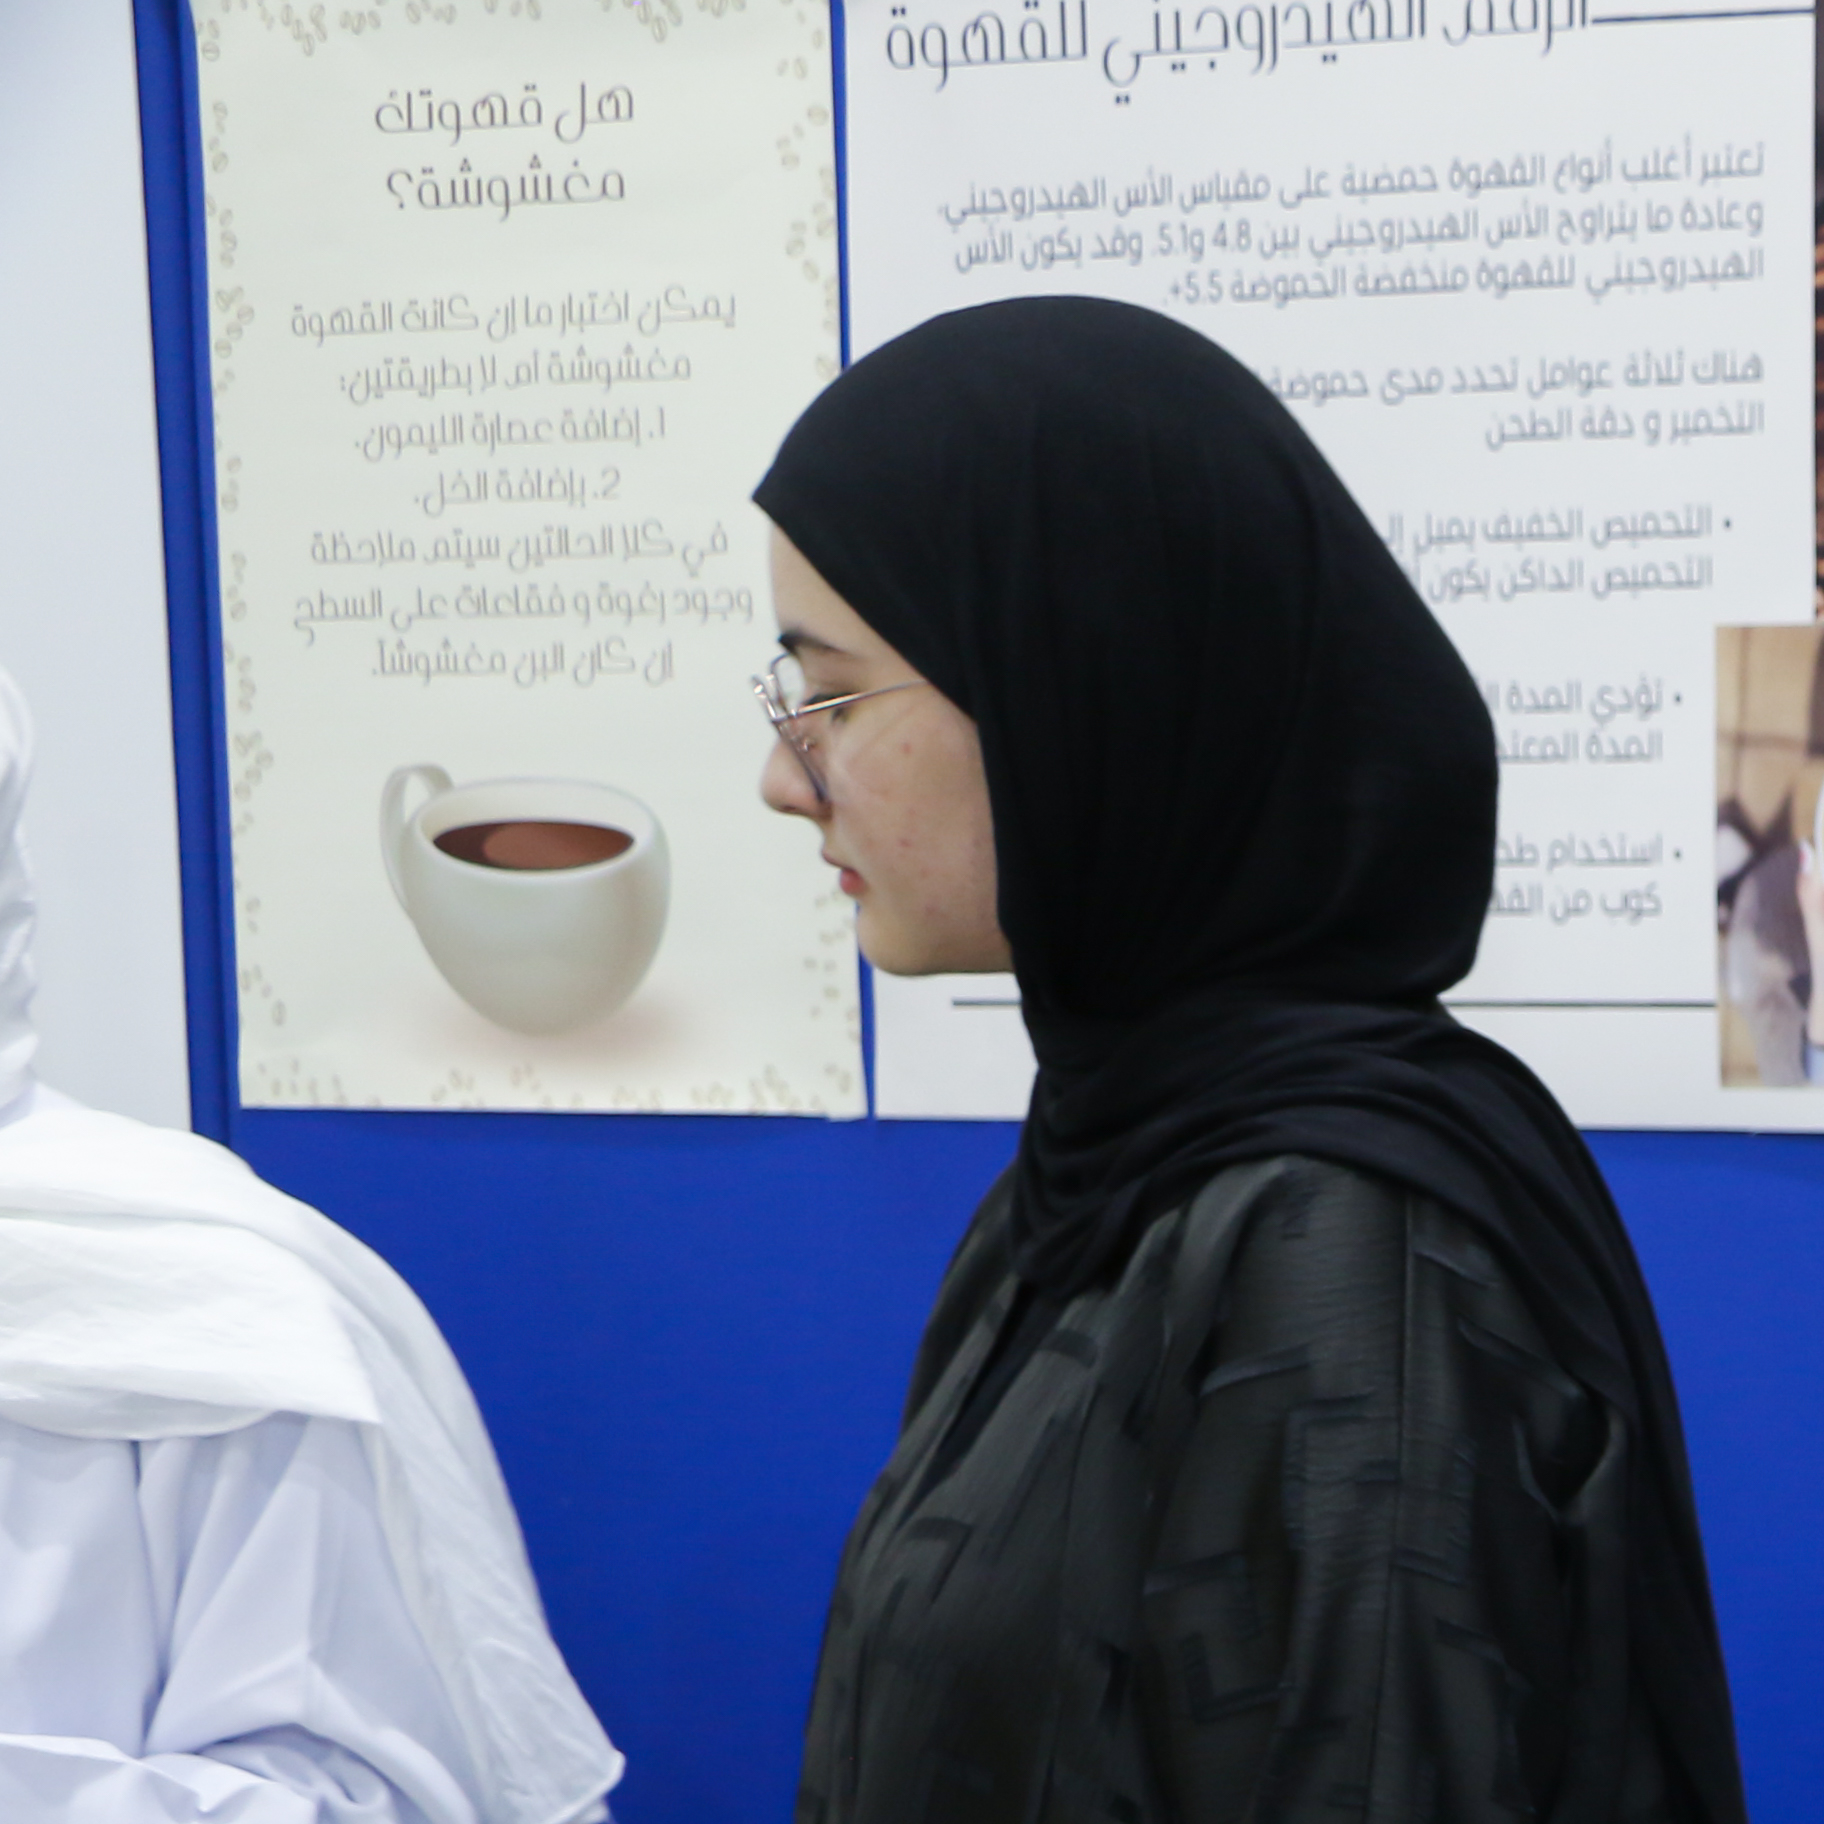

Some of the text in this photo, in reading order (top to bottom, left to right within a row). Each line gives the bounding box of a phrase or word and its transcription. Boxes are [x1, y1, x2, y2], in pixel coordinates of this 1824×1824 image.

[887, 0, 1087, 94] للقهوة
[375, 81, 634, 147] هل قهوتك
[387, 153, 625, 223] مغشوشة؟
[291, 299, 394, 348] القهوة
[401, 293, 480, 333] كانت
[524, 293, 552, 328] ما
[560, 289, 629, 337] اختبار
[638, 283, 735, 337] يمكن
[480, 353, 497, 393] لا
[505, 348, 540, 391] أم
[547, 342, 691, 393] مغشوشة
[472, 411, 553, 457] عصارة
[561, 405, 641, 448] إضافة
[496, 467, 586, 508] بإضافة
[593, 466, 620, 499] 2.
[311, 518, 728, 578] في كلا الحالتين سيتم ملاحظة
[293, 580, 754, 647] وجود رغوة و فقاعات على السطح
[514, 640, 565, 688] البن
[573, 635, 636, 687] كان
